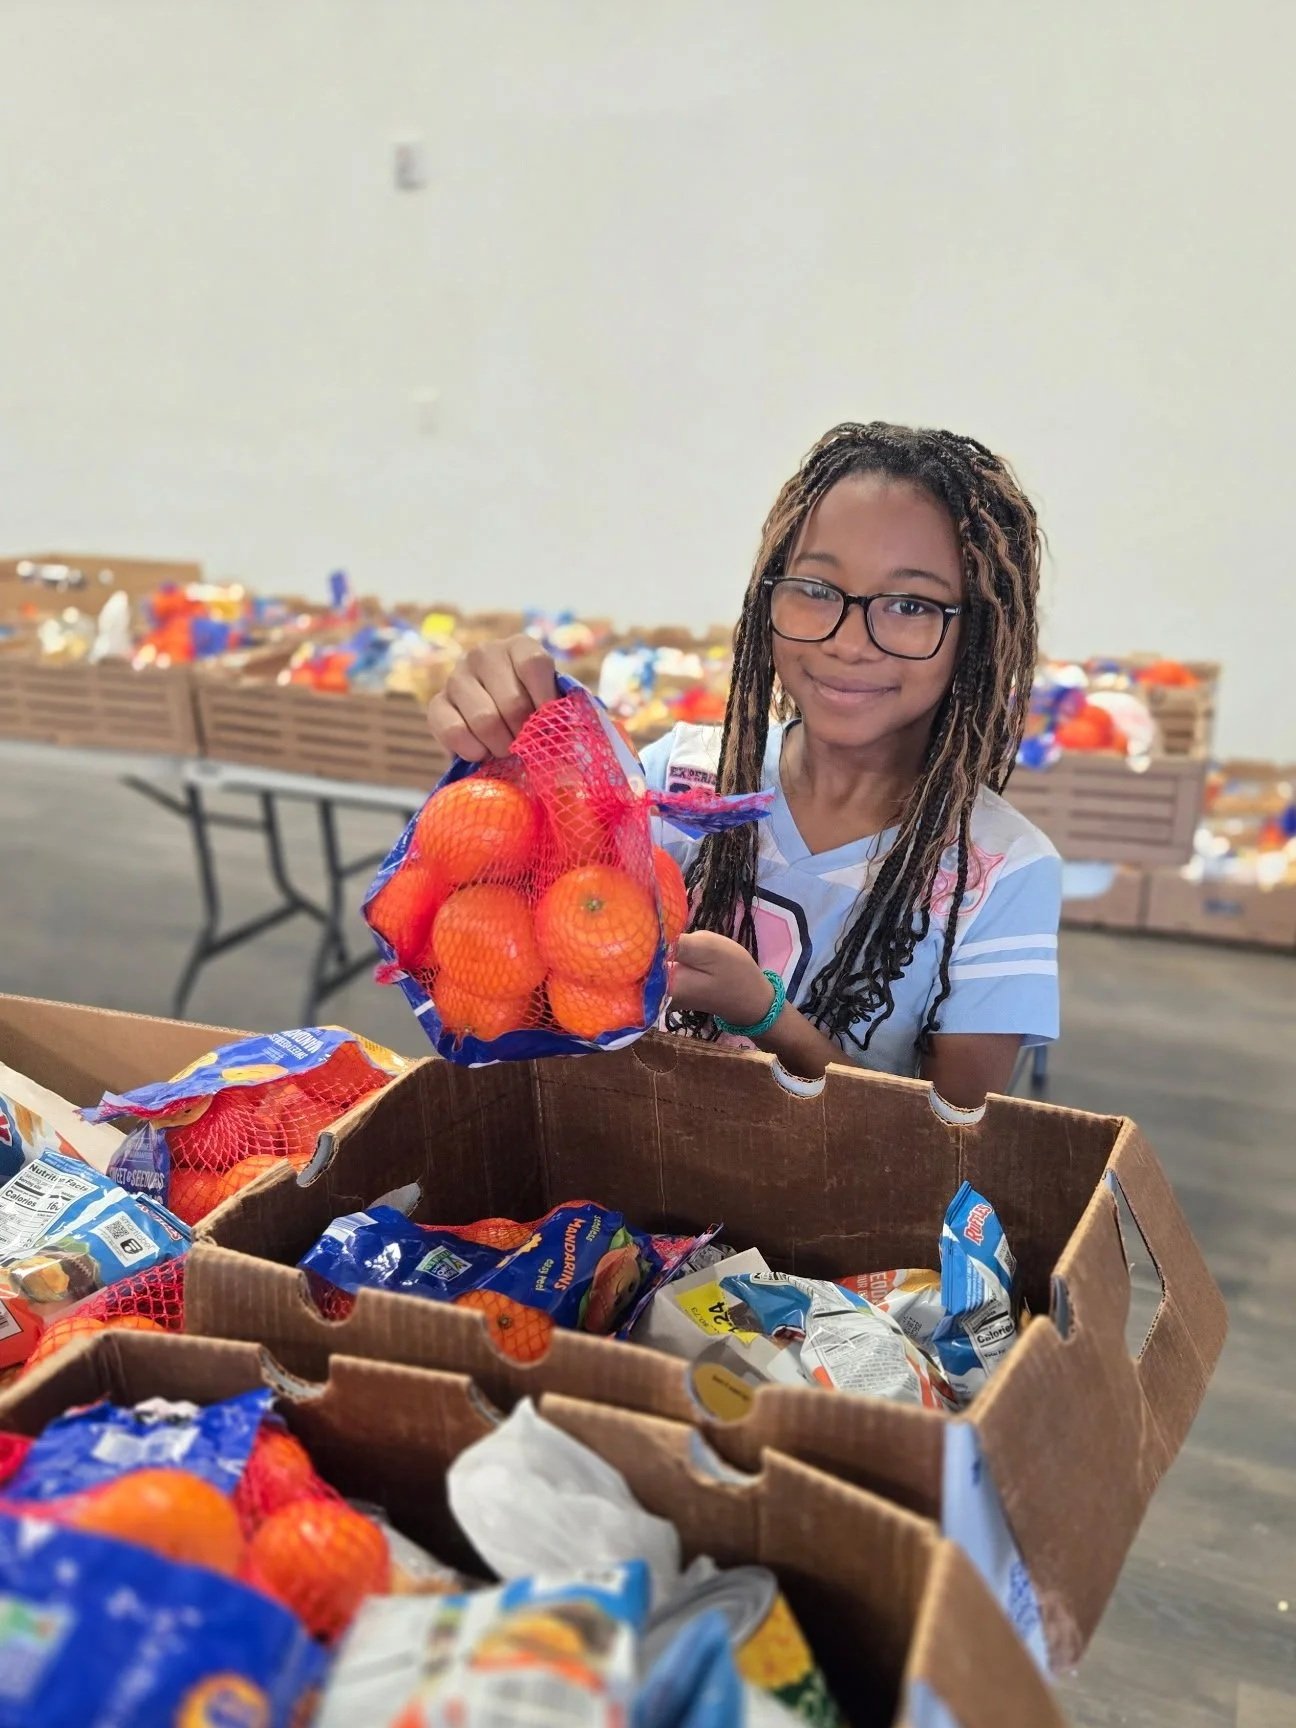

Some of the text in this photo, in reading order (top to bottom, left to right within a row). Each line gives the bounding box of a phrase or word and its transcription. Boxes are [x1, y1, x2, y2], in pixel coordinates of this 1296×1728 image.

[65, 1178, 89, 1192] Facts
[5, 1189, 37, 1207] Calories
[586, 1215, 601, 1242] seedless
[964, 1204, 992, 1246] RUFFLES
[554, 1218, 586, 1291] MANDARINS
[538, 1258, 555, 1276] easy
